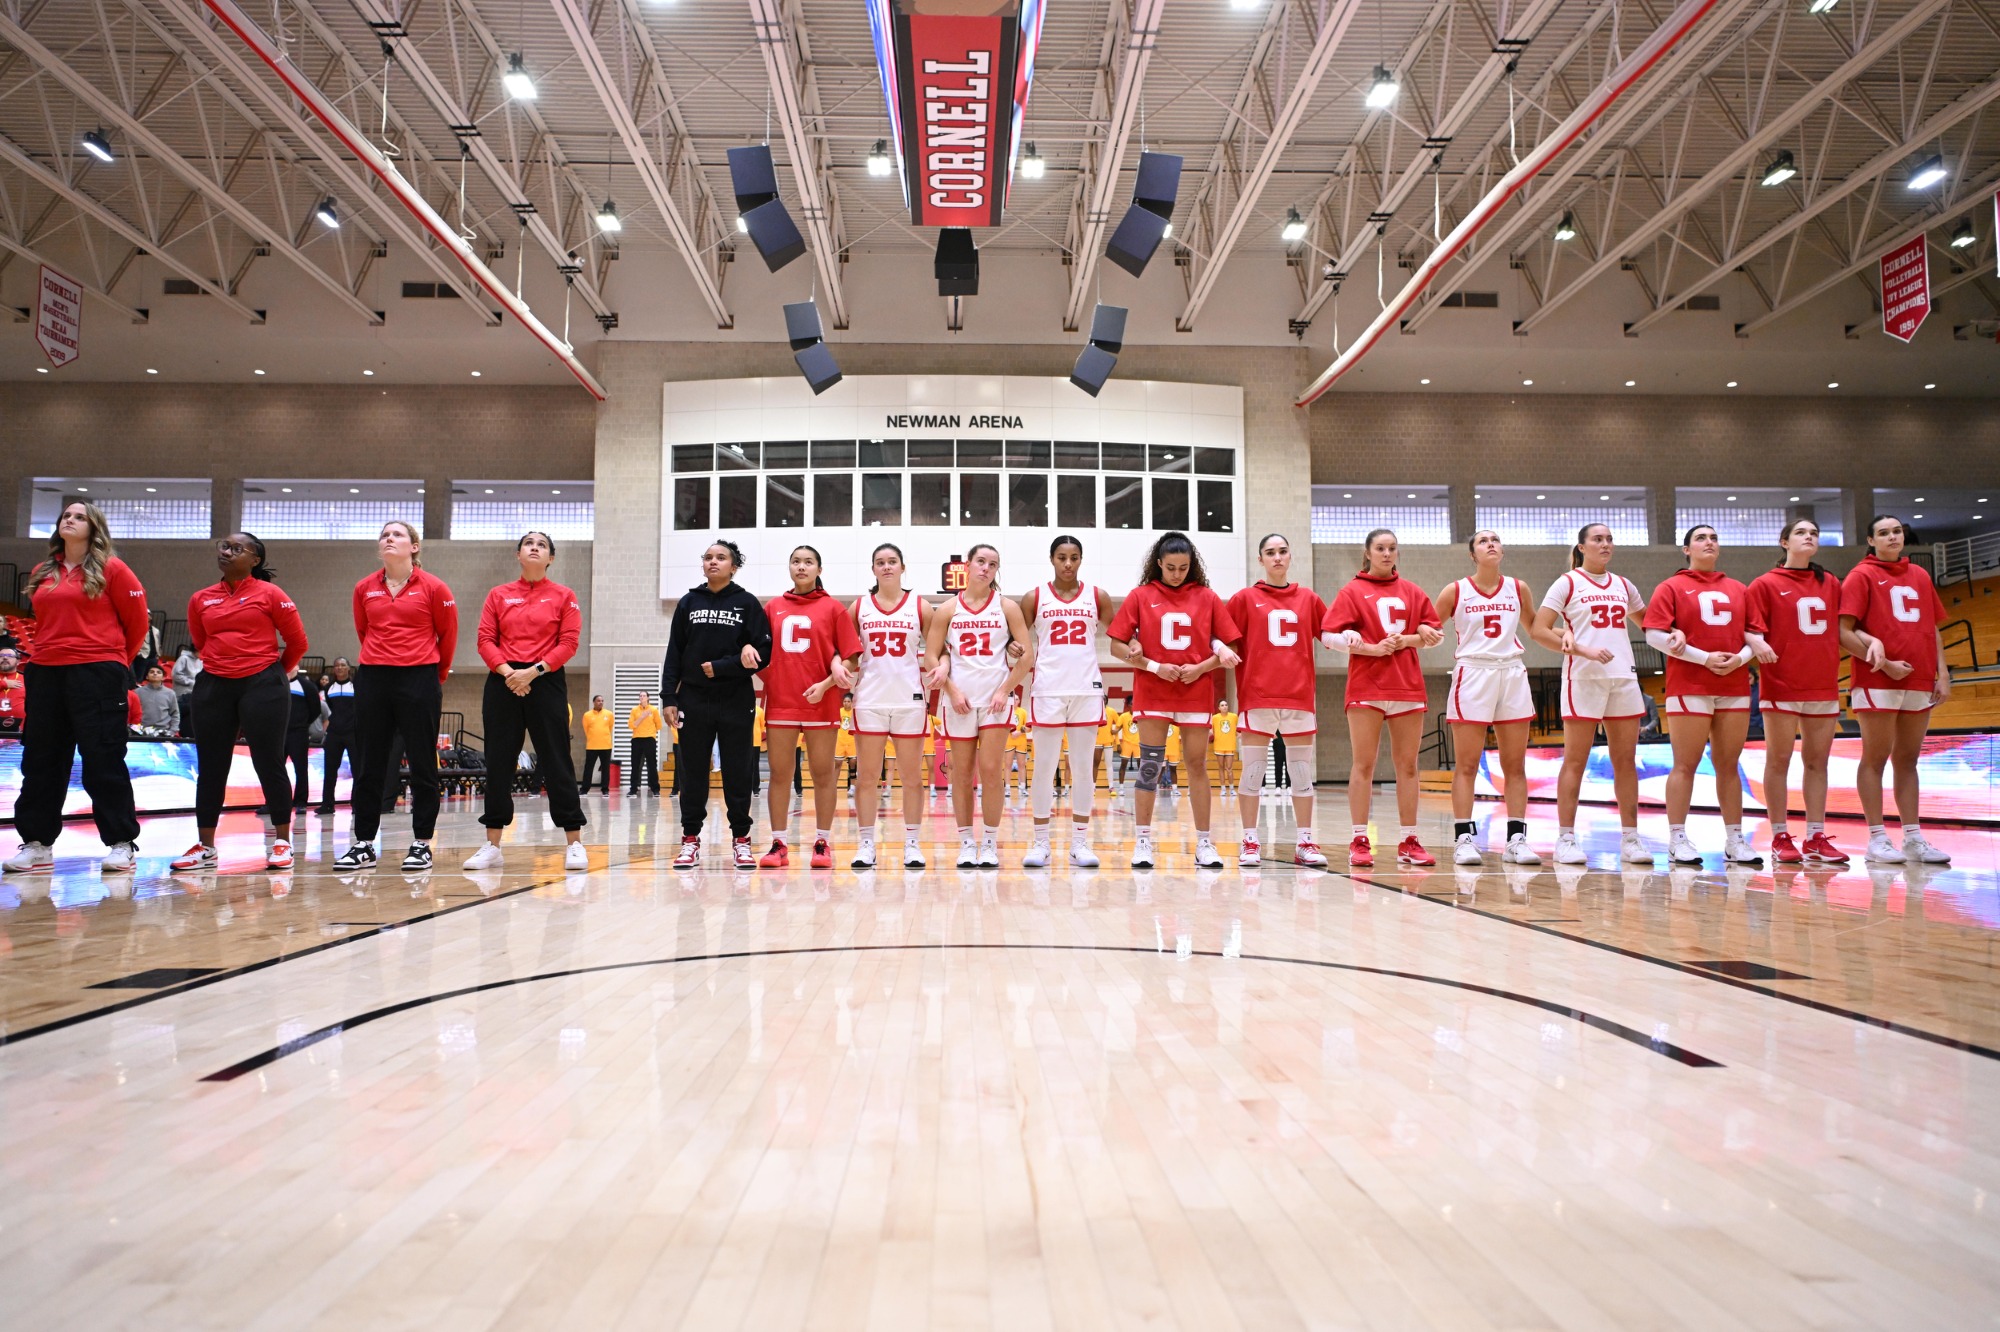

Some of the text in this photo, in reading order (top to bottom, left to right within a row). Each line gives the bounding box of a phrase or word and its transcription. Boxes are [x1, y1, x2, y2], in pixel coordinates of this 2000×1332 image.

[923, 50, 992, 208] CORNELL
[1884, 246, 1922, 276] CORNELL
[1885, 263, 1923, 288] VOLLEYBALL
[44, 277, 78, 305] CORNELL
[1887, 278, 1923, 303] IVY LEAGUE
[43, 304, 77, 327] BASKETBALL
[53, 299, 68, 313] MEN'S
[1887, 293, 1926, 322] CHAMPIONS
[52, 320, 66, 335] NCAA
[1899, 319, 1915, 334] 1991
[887, 415, 1024, 428] NEWMAN ARENA
[946, 571, 967, 589] 30
[1465, 603, 1516, 614] CORNELL
[1581, 594, 1628, 604] CORNELL
[1698, 591, 1732, 625] C
[1890, 585, 1920, 622] C
[689, 609, 743, 624] CORNELL
[862, 620, 914, 631] CORNELL
[951, 620, 1002, 630] CORNELL
[1042, 609, 1093, 619] CORNELL
[1376, 597, 1406, 635] C
[1591, 605, 1626, 629] 32
[1796, 597, 1827, 635] C
[781, 615, 812, 653] C
[1051, 620, 1087, 645] 22
[1161, 612, 1191, 650] C
[1268, 609, 1298, 647] C
[1484, 615, 1501, 638] 5
[869, 632, 907, 657] 33
[959, 632, 993, 656] 21
